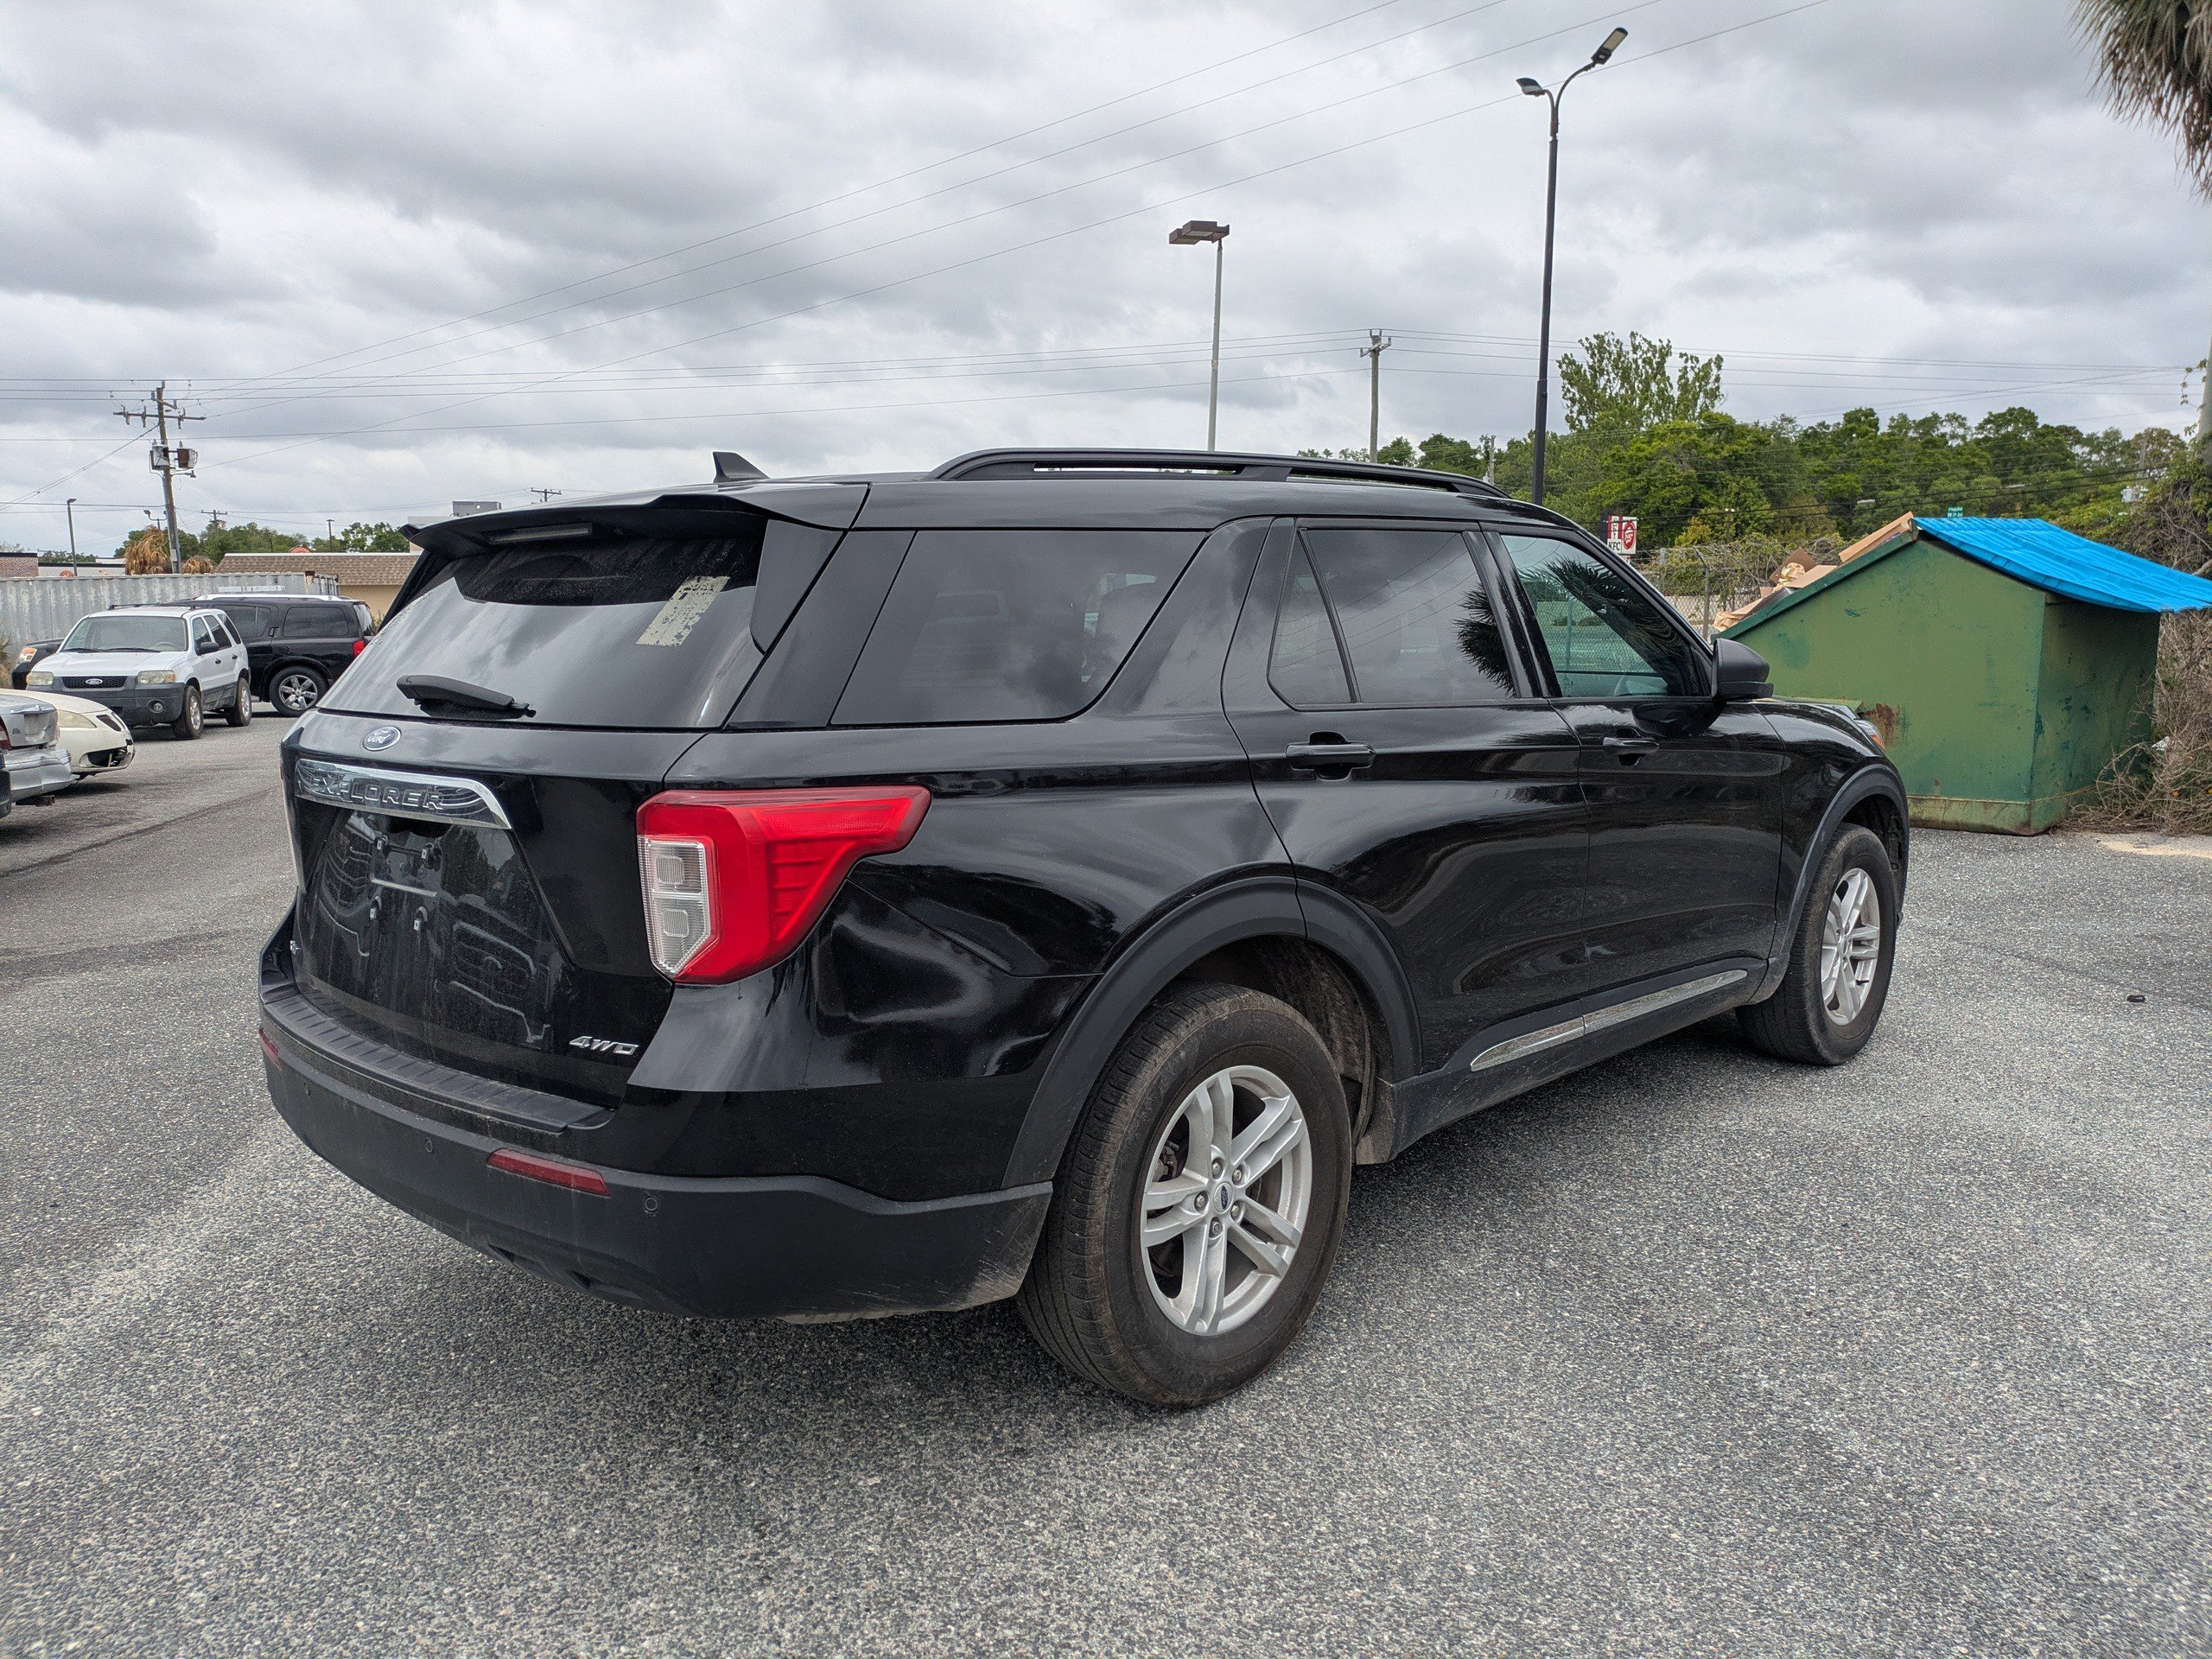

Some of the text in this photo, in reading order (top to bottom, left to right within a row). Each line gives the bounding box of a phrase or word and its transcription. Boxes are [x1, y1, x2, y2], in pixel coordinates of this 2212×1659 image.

[1608, 541, 1621, 551] KFC
[309, 775, 444, 810] EXPLORER
[569, 1035, 639, 1056] 4WD
